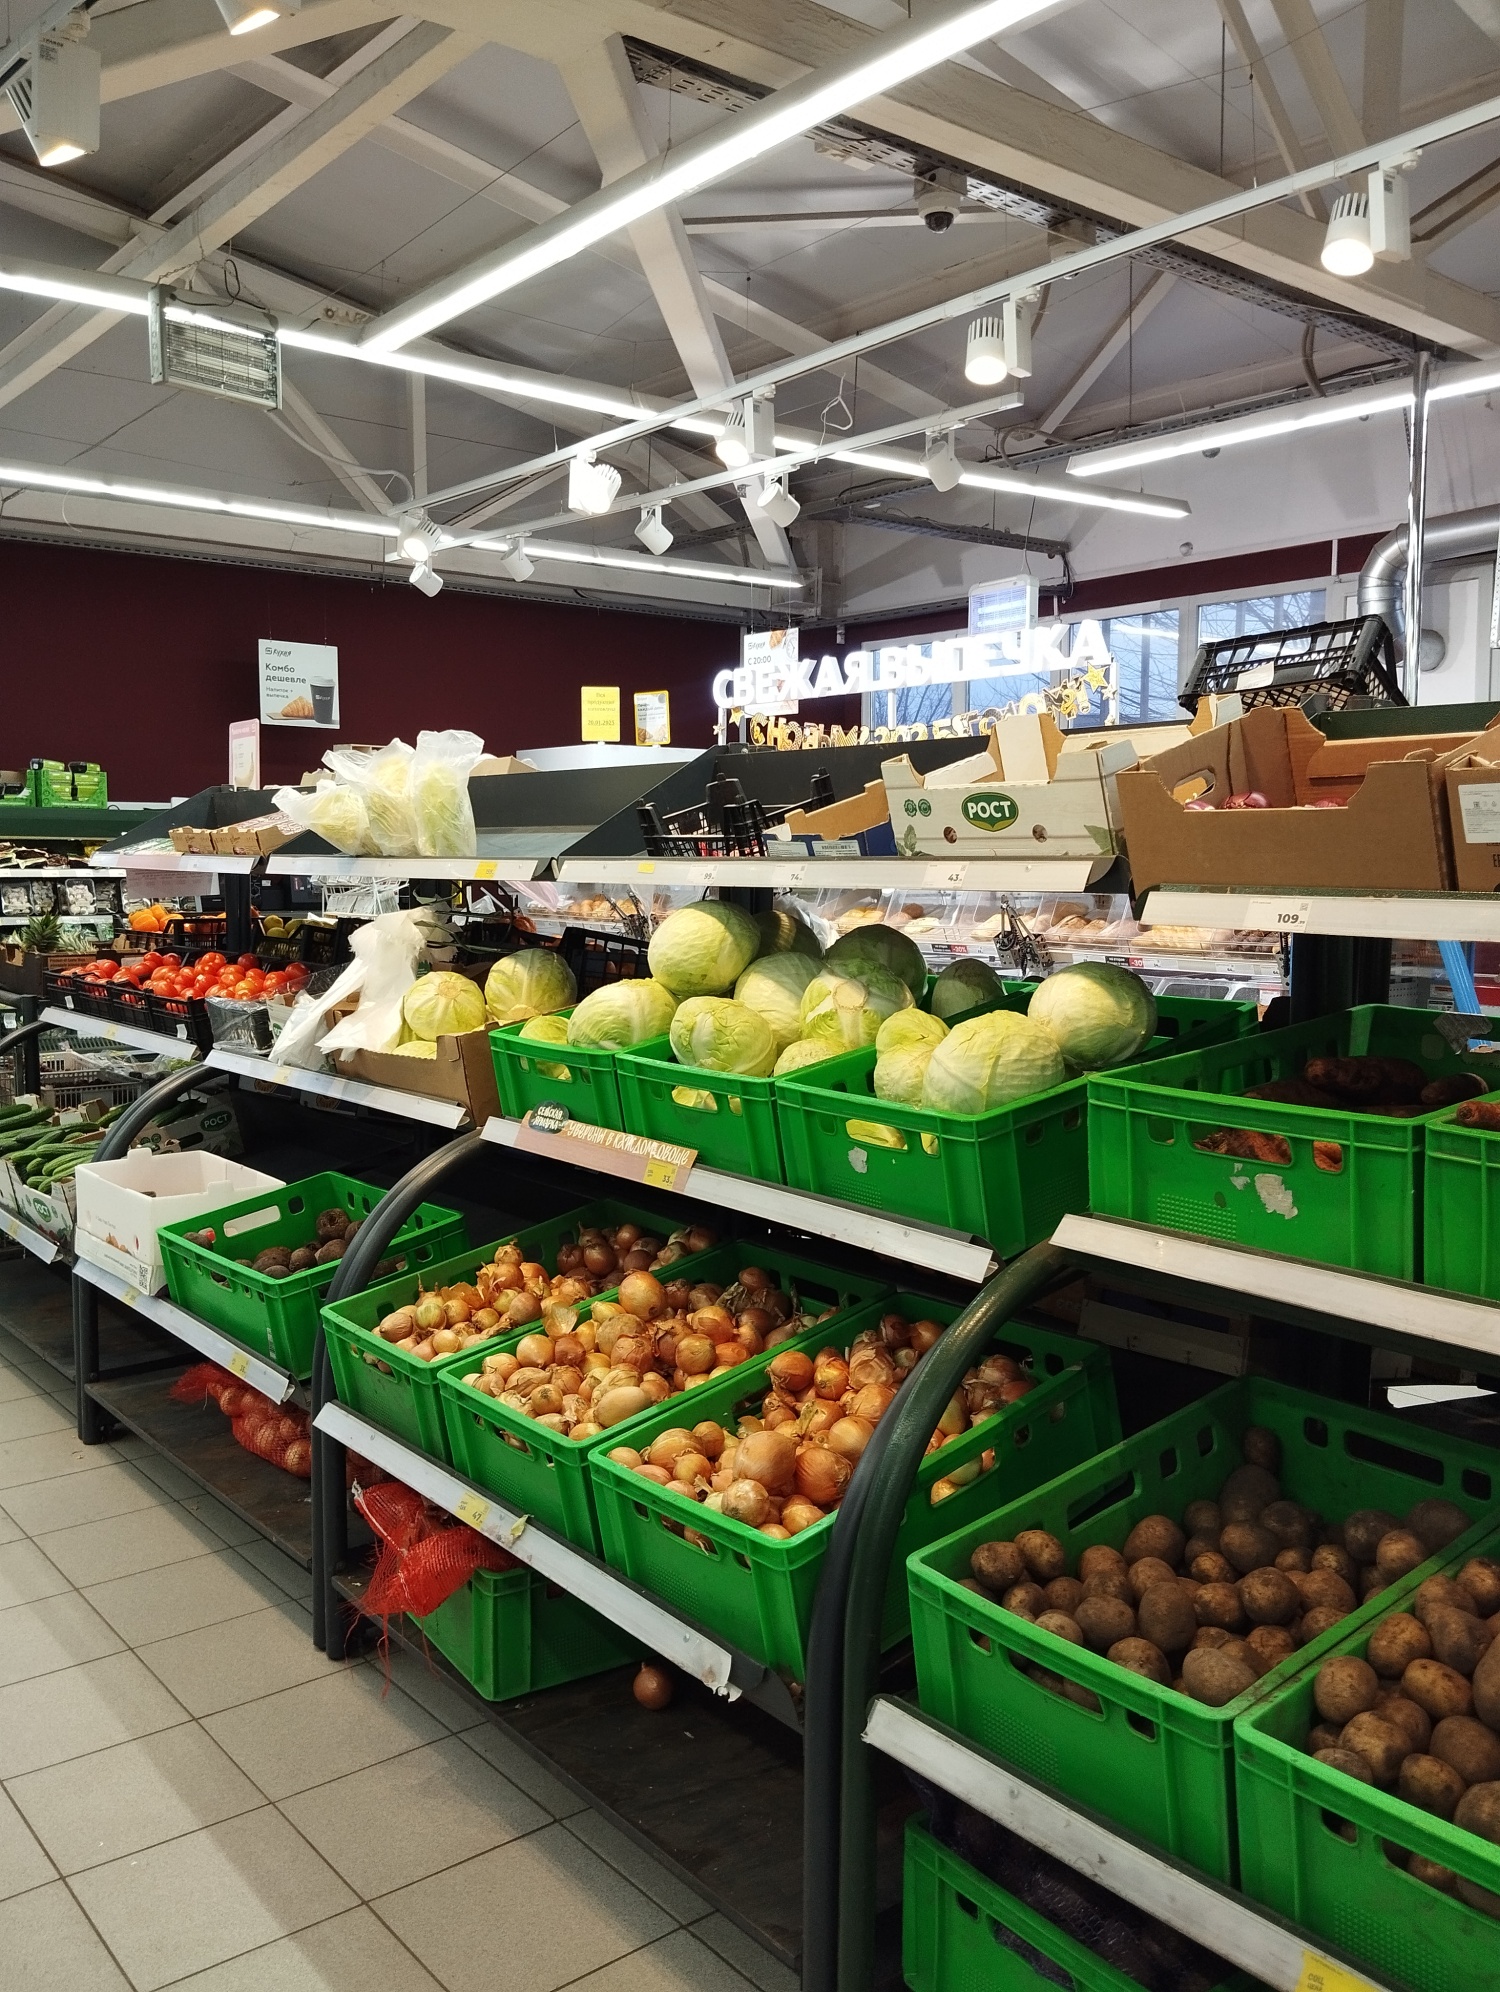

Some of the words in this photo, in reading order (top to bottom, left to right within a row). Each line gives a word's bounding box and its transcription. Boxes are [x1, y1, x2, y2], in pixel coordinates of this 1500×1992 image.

[713, 650, 870, 709] СВЕЖАЯ
[879, 619, 1111, 690] ВЫПЕЧКА
[753, 655, 772, 665] 20:00
[265, 663, 295, 673] Комбо
[265, 675, 307, 685] дешевле
[967, 800, 1011, 819] РОСТ
[204, 1113, 228, 1128] РОСТ
[567, 1121, 606, 1144] УВЕРЕНЫ
